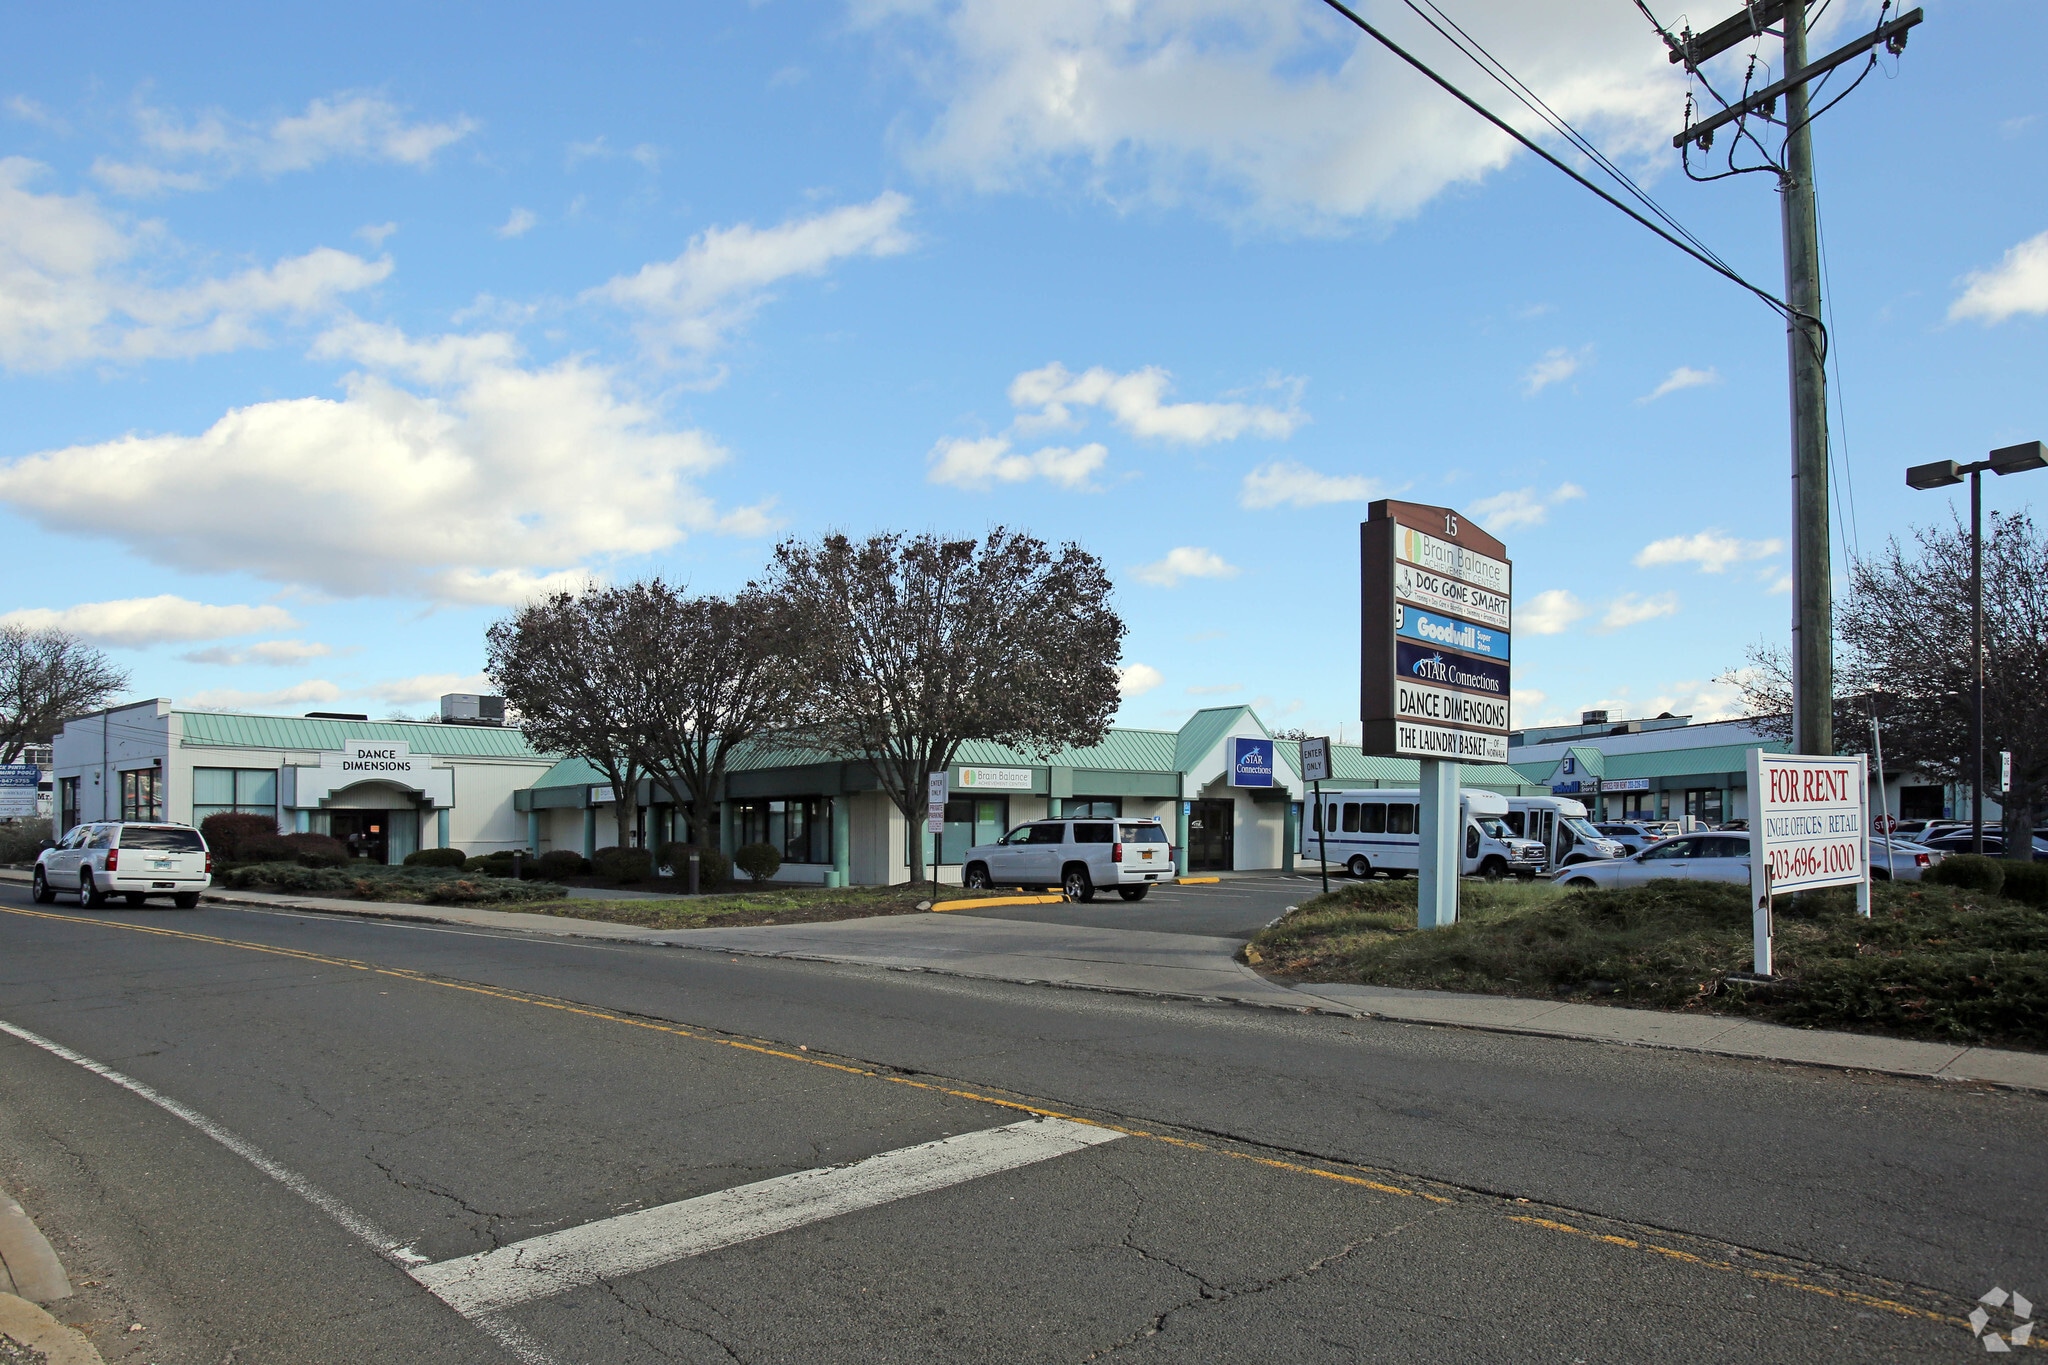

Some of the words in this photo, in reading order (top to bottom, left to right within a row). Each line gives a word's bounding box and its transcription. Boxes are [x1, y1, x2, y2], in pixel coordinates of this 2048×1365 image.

[1444, 513, 1458, 537] 15
[1423, 535, 1454, 563] Brain
[1457, 547, 1501, 581] Balance
[1424, 558, 1471, 581] ACHIEVEMENT
[1473, 574, 1501, 591] CENTERS
[1416, 572, 1439, 594] DOG
[1442, 581, 1468, 603] GONE
[1471, 591, 1507, 615] SMART
[1417, 616, 1475, 649] Goodwill
[1477, 630, 1492, 642] Super
[1477, 640, 1491, 653] Store
[1419, 657, 1447, 682] STAR
[1448, 665, 1500, 692] Connections
[1400, 688, 1440, 717] DANCE
[1443, 696, 1505, 727] DIMENSIONS
[1399, 727, 1416, 749] THE
[1419, 729, 1458, 753] LAUNDRY
[1459, 734, 1487, 757] BASKET
[1493, 738, 1499, 748] OF
[358, 749, 396, 759] DANCE
[1245, 754, 1264, 765] STAR
[1304, 748, 1323, 759] ENTER
[1487, 748, 1505, 759] NORWALK
[342, 761, 411, 771] DIMENSIONS
[1236, 763, 1272, 775] Connections
[1306, 761, 1322, 772] ONLY
[977, 770, 997, 780] Brain
[998, 771, 1028, 782] Balance
[930, 779, 943, 787] ENTER
[1769, 768, 1800, 804] FOR
[1803, 769, 1849, 803] RENT
[928, 811, 943, 819] PARKING
[1766, 816, 1790, 838] INGLE
[1790, 814, 1822, 837] OFFICES
[1828, 813, 1859, 834] RETAIL
[1874, 819, 1895, 830] STP
[1768, 843, 1855, 881] 203-696-1000
